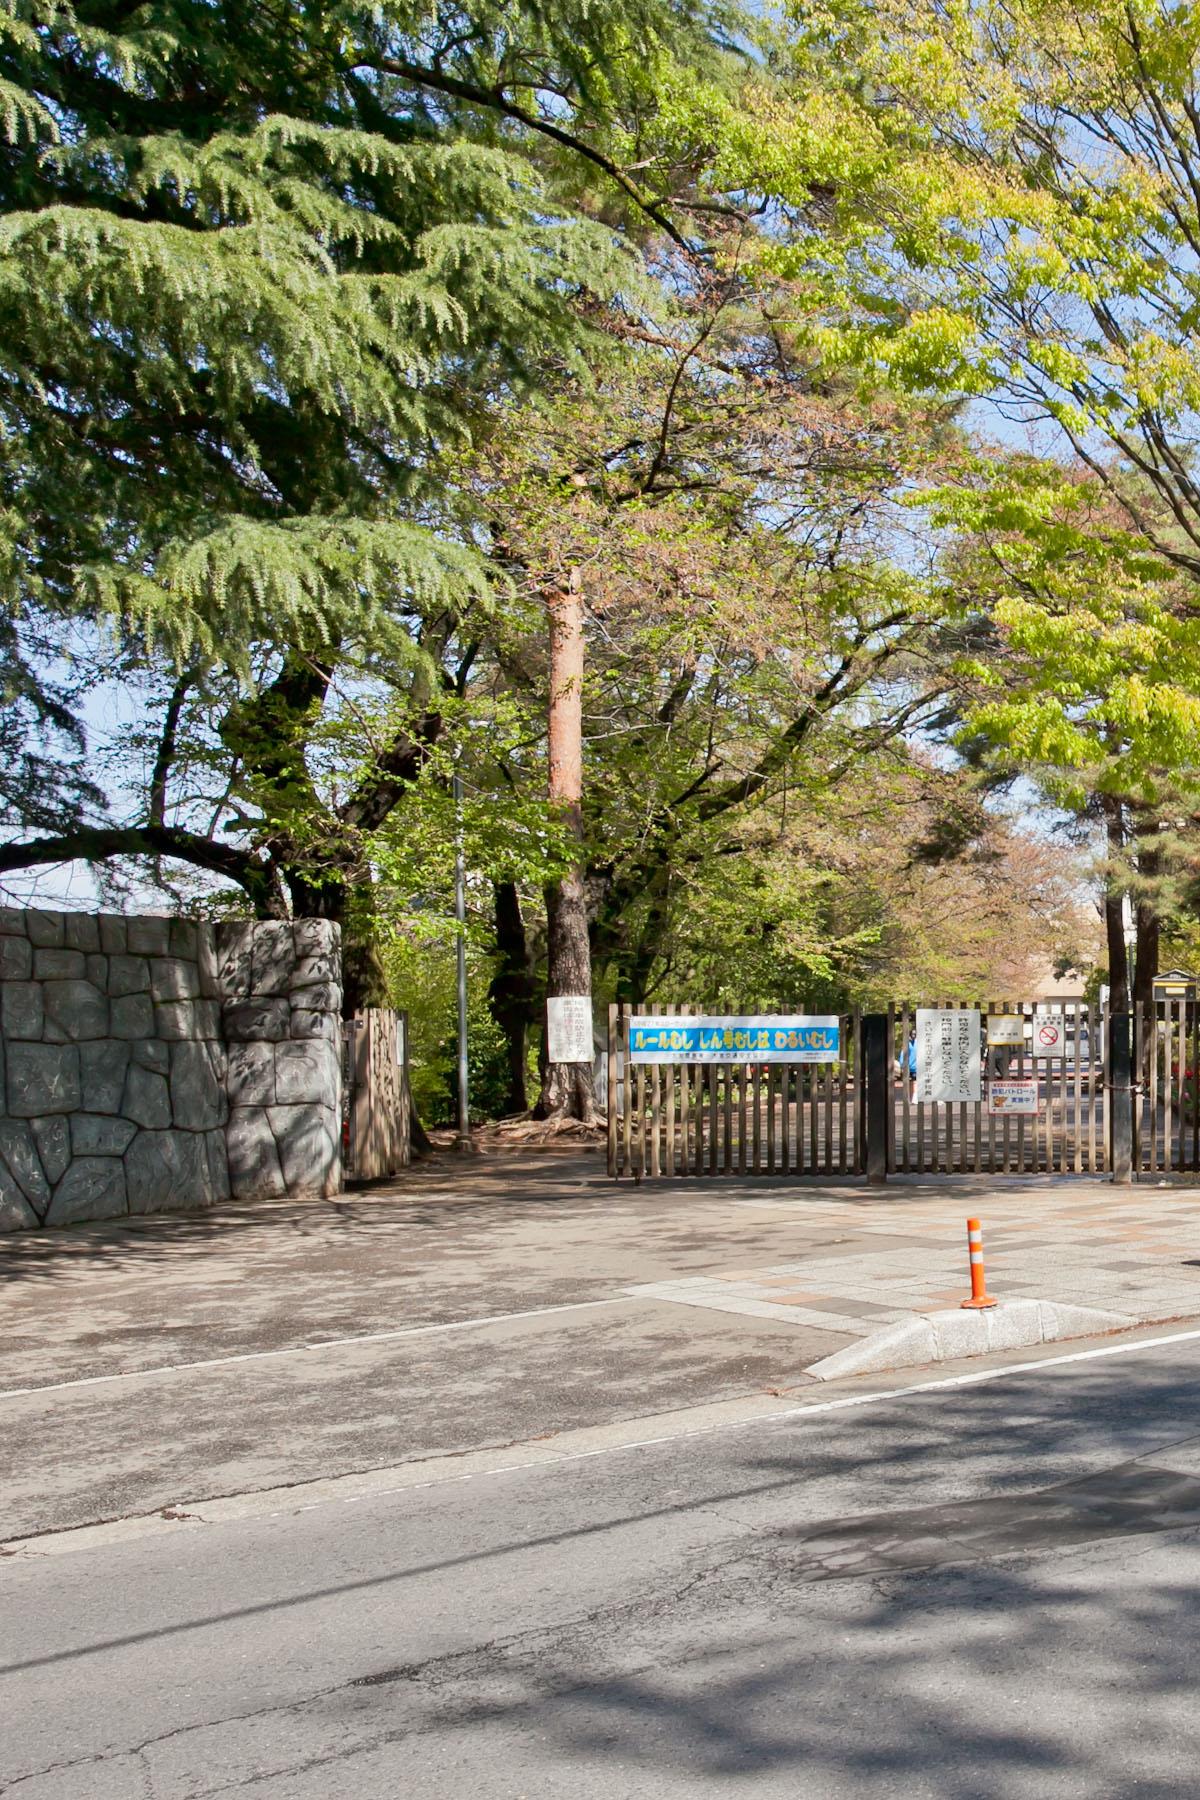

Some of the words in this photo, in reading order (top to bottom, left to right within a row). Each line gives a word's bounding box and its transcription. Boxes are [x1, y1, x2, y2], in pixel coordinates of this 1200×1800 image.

[635, 1031, 694, 1049] ルールむし
[699, 1030, 770, 1050] しん号むしは
[774, 1031, 834, 1049] わるいむし
